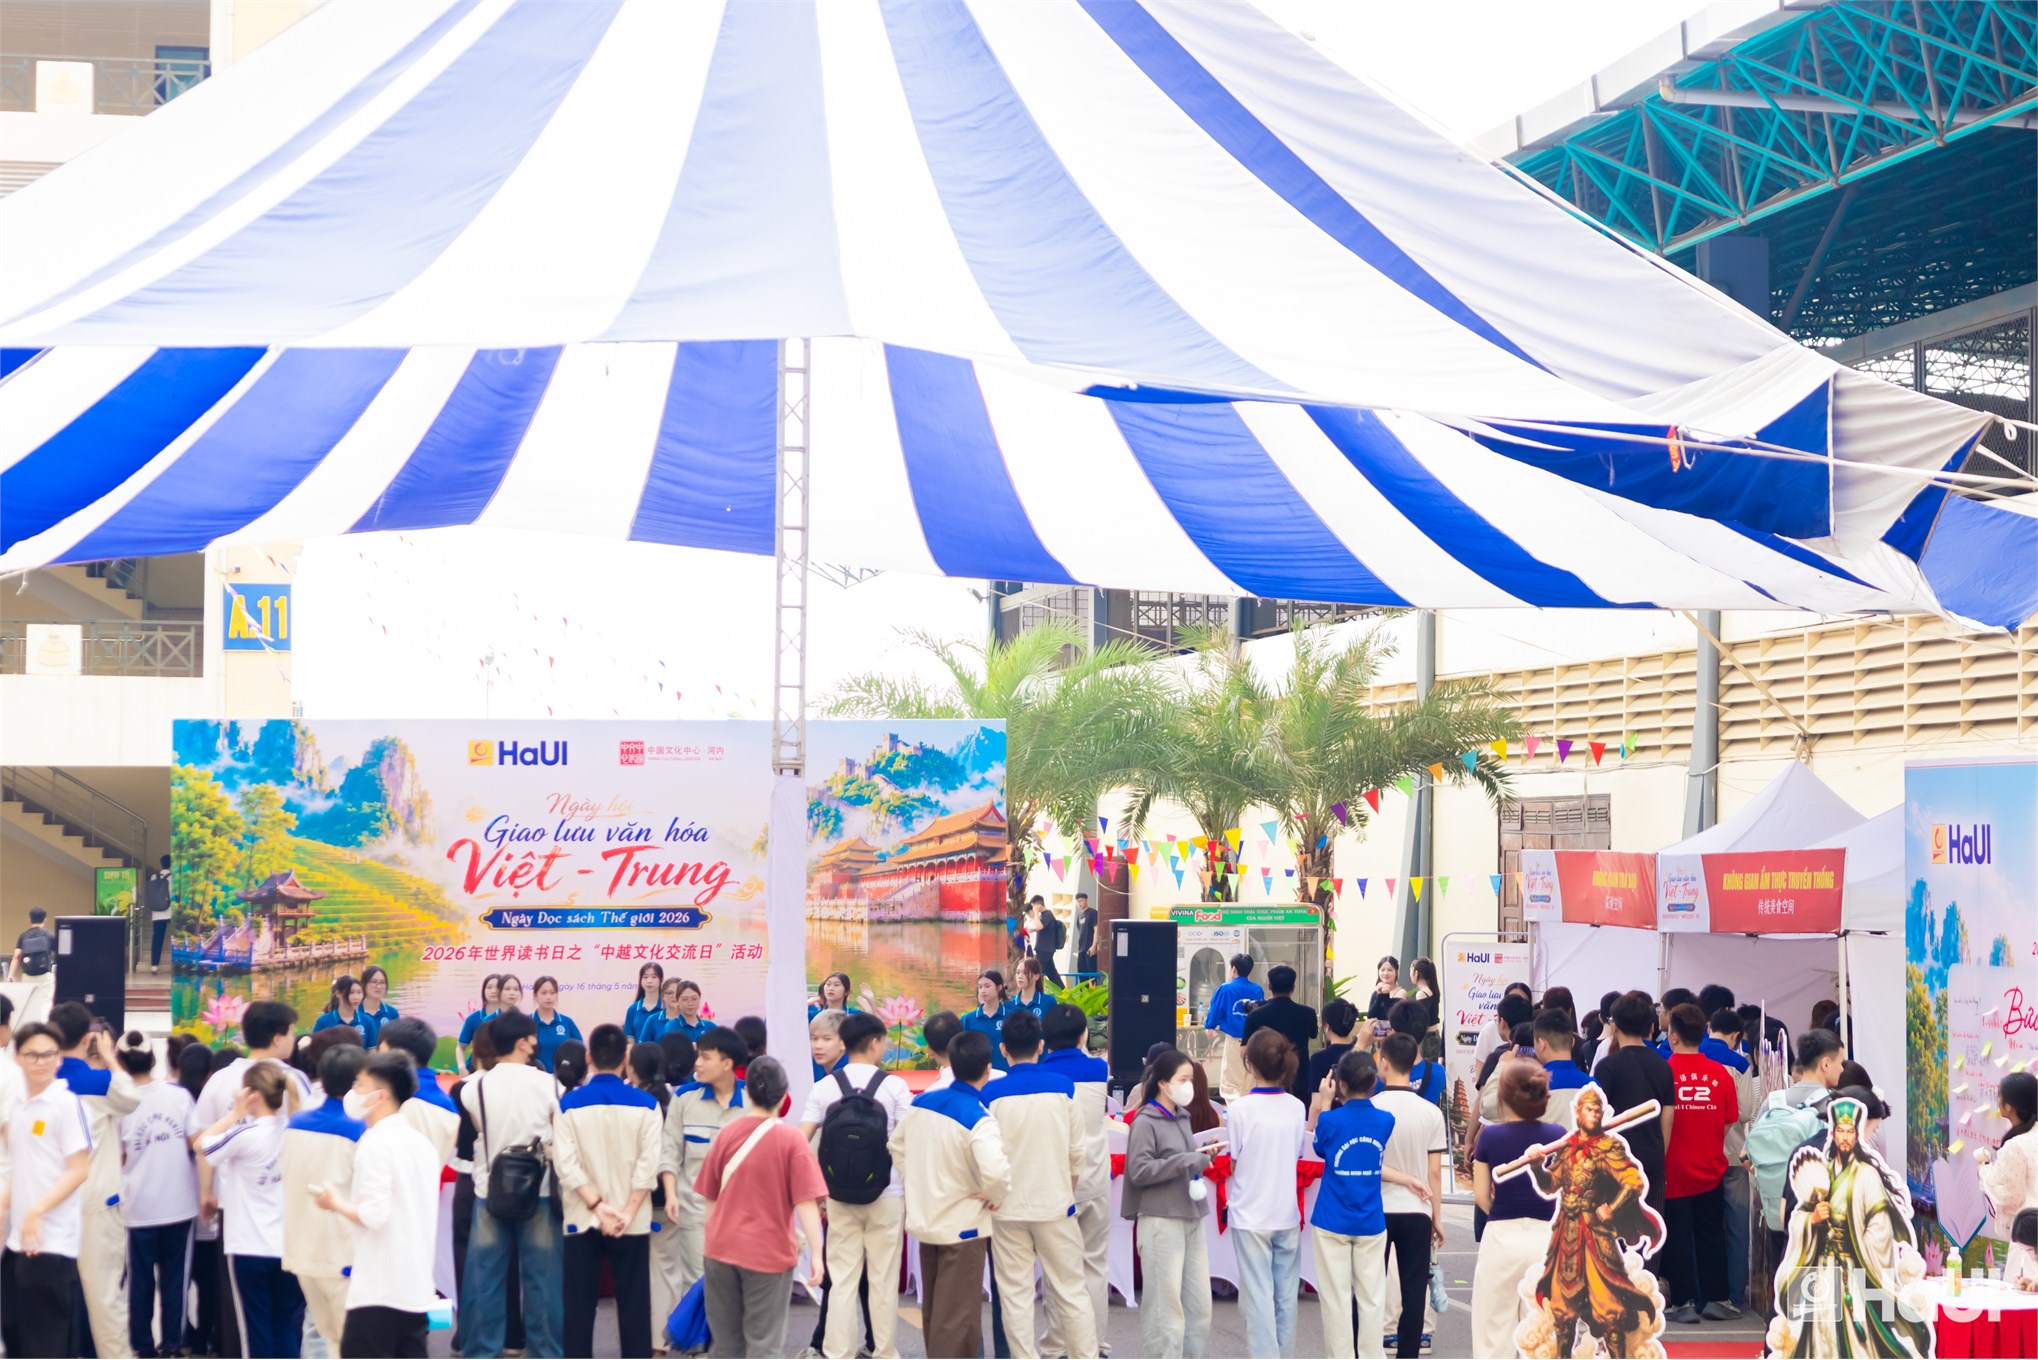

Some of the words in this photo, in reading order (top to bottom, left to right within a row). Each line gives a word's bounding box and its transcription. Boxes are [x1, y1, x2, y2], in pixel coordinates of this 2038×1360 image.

[499, 740, 568, 766] HaUI
[648, 746, 700, 755] 中国文化中心
[707, 746, 724, 755] 河内
[546, 792, 604, 821] Ngày
[484, 814, 548, 849] Giao
[553, 818, 596, 842] lưu
[606, 821, 653, 842] văn
[664, 816, 711, 842] hóa
[1949, 824, 1991, 865] HaUI
[446, 838, 573, 898] Việt
[601, 845, 740, 906] Trung
[501, 911, 533, 928] Ngày
[537, 911, 562, 926] Đọc
[566, 911, 595, 924] sách
[600, 911, 627, 924] Thế
[630, 911, 655, 927] giới
[658, 911, 690, 924] 2026
[1195, 908, 1222, 922] Food
[1467, 952, 1490, 963] HaUI
[1468, 987, 1487, 1001] Giao
[1456, 1009, 1486, 1026] Việt
[1678, 1086, 1711, 1101] C2
